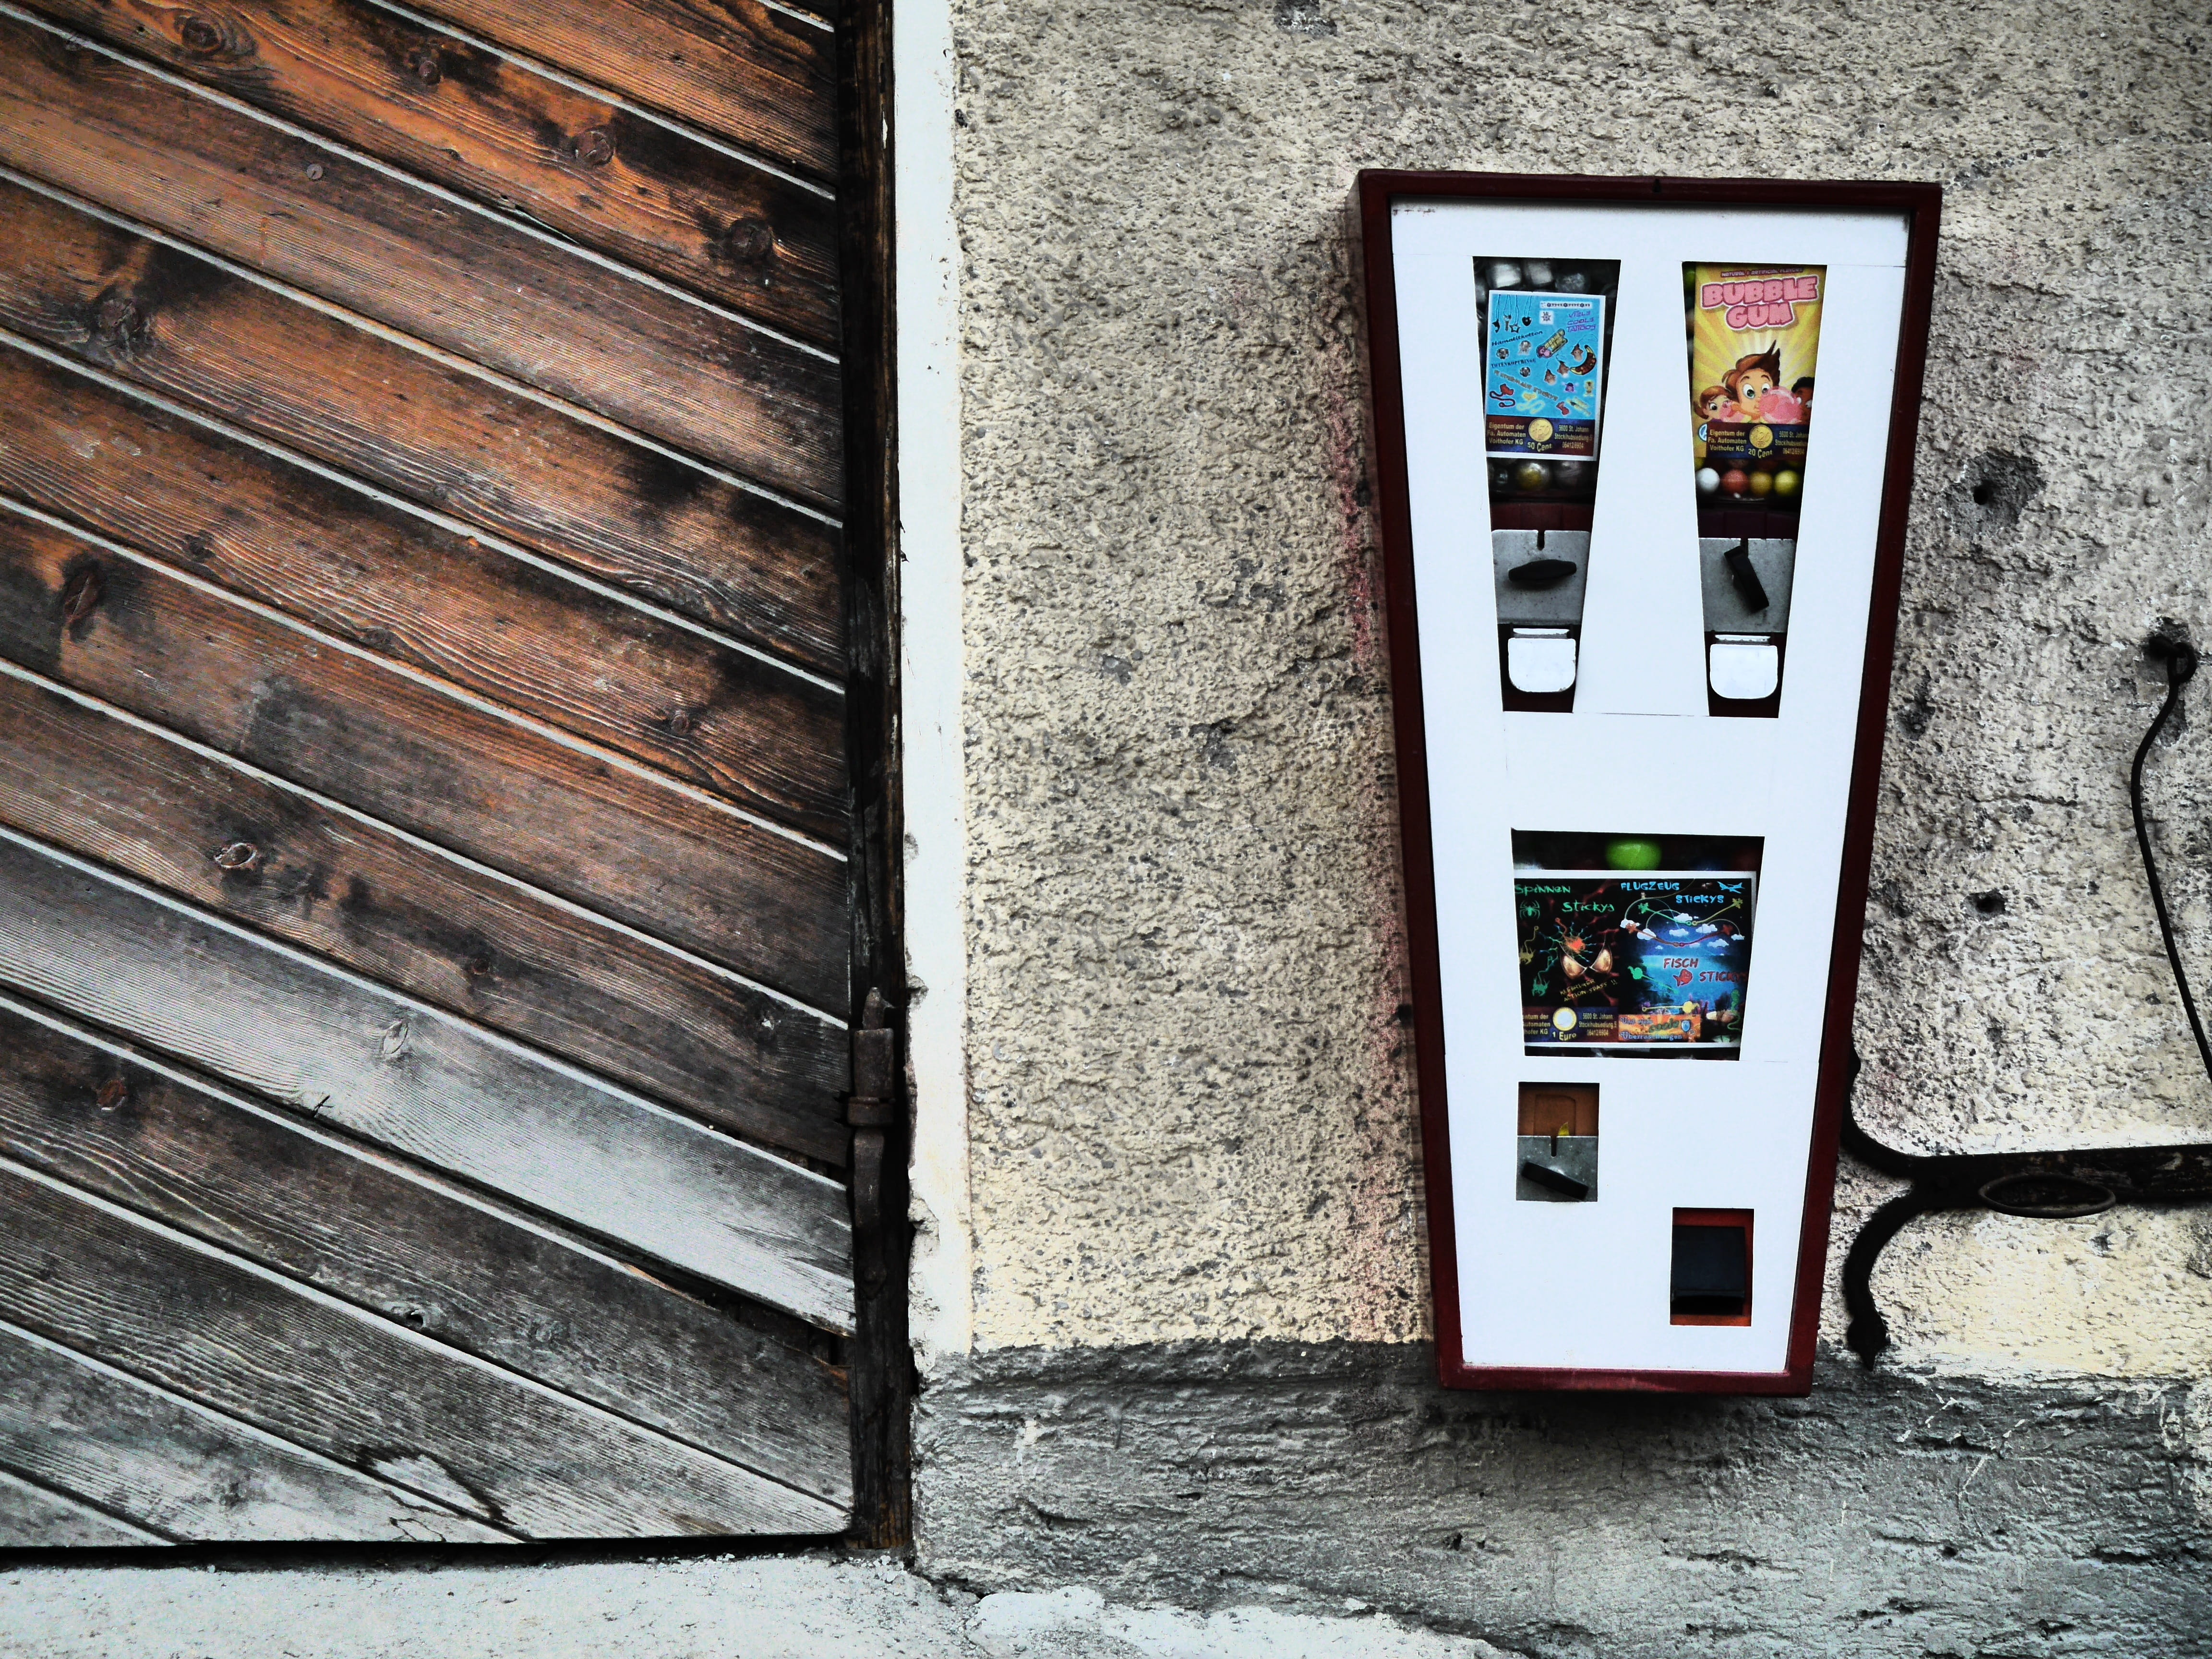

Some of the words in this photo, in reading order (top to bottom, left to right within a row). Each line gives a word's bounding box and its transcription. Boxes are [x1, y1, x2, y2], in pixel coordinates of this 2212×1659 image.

[1702, 276, 1818, 307] BUBBLE
[1726, 301, 1793, 329] GUM
[1489, 422, 1514, 430] Eigentum
[1527, 442, 1535, 450] 50
[1537, 443, 1552, 452] Cent
[1748, 448, 1756, 457] 20
[1757, 449, 1773, 459] Cent
[1621, 881, 1680, 891] FLUGZEUG
[1663, 958, 1699, 969] FISCH
[1563, 990, 1587, 1002] ACTION
[1649, 1018, 1680, 1033] coole
[1559, 1032, 1577, 1041] Euro
